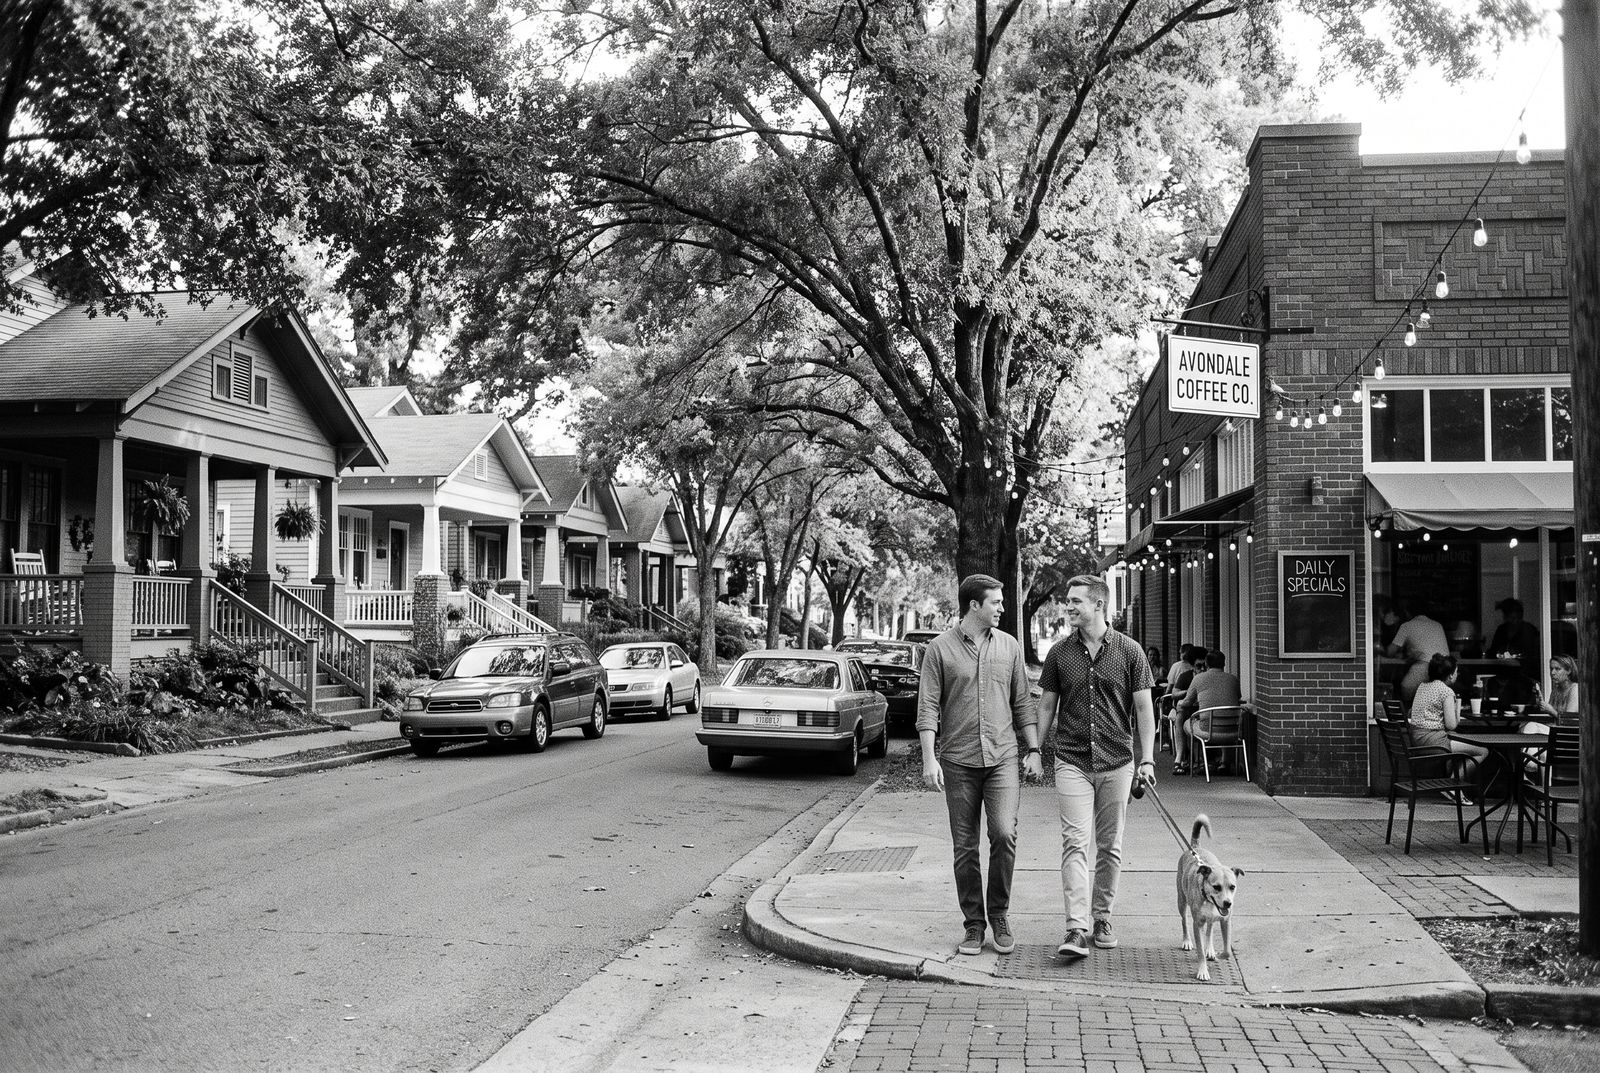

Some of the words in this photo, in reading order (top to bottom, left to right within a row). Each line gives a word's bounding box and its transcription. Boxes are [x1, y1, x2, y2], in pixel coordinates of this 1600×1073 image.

[1179, 350, 1250, 377] AVONDALE
[1177, 378, 1227, 402] COFFEE
[1232, 383, 1253, 405] CO.
[1295, 560, 1335, 575] DAILY
[1287, 577, 1346, 592] SPECIALS
